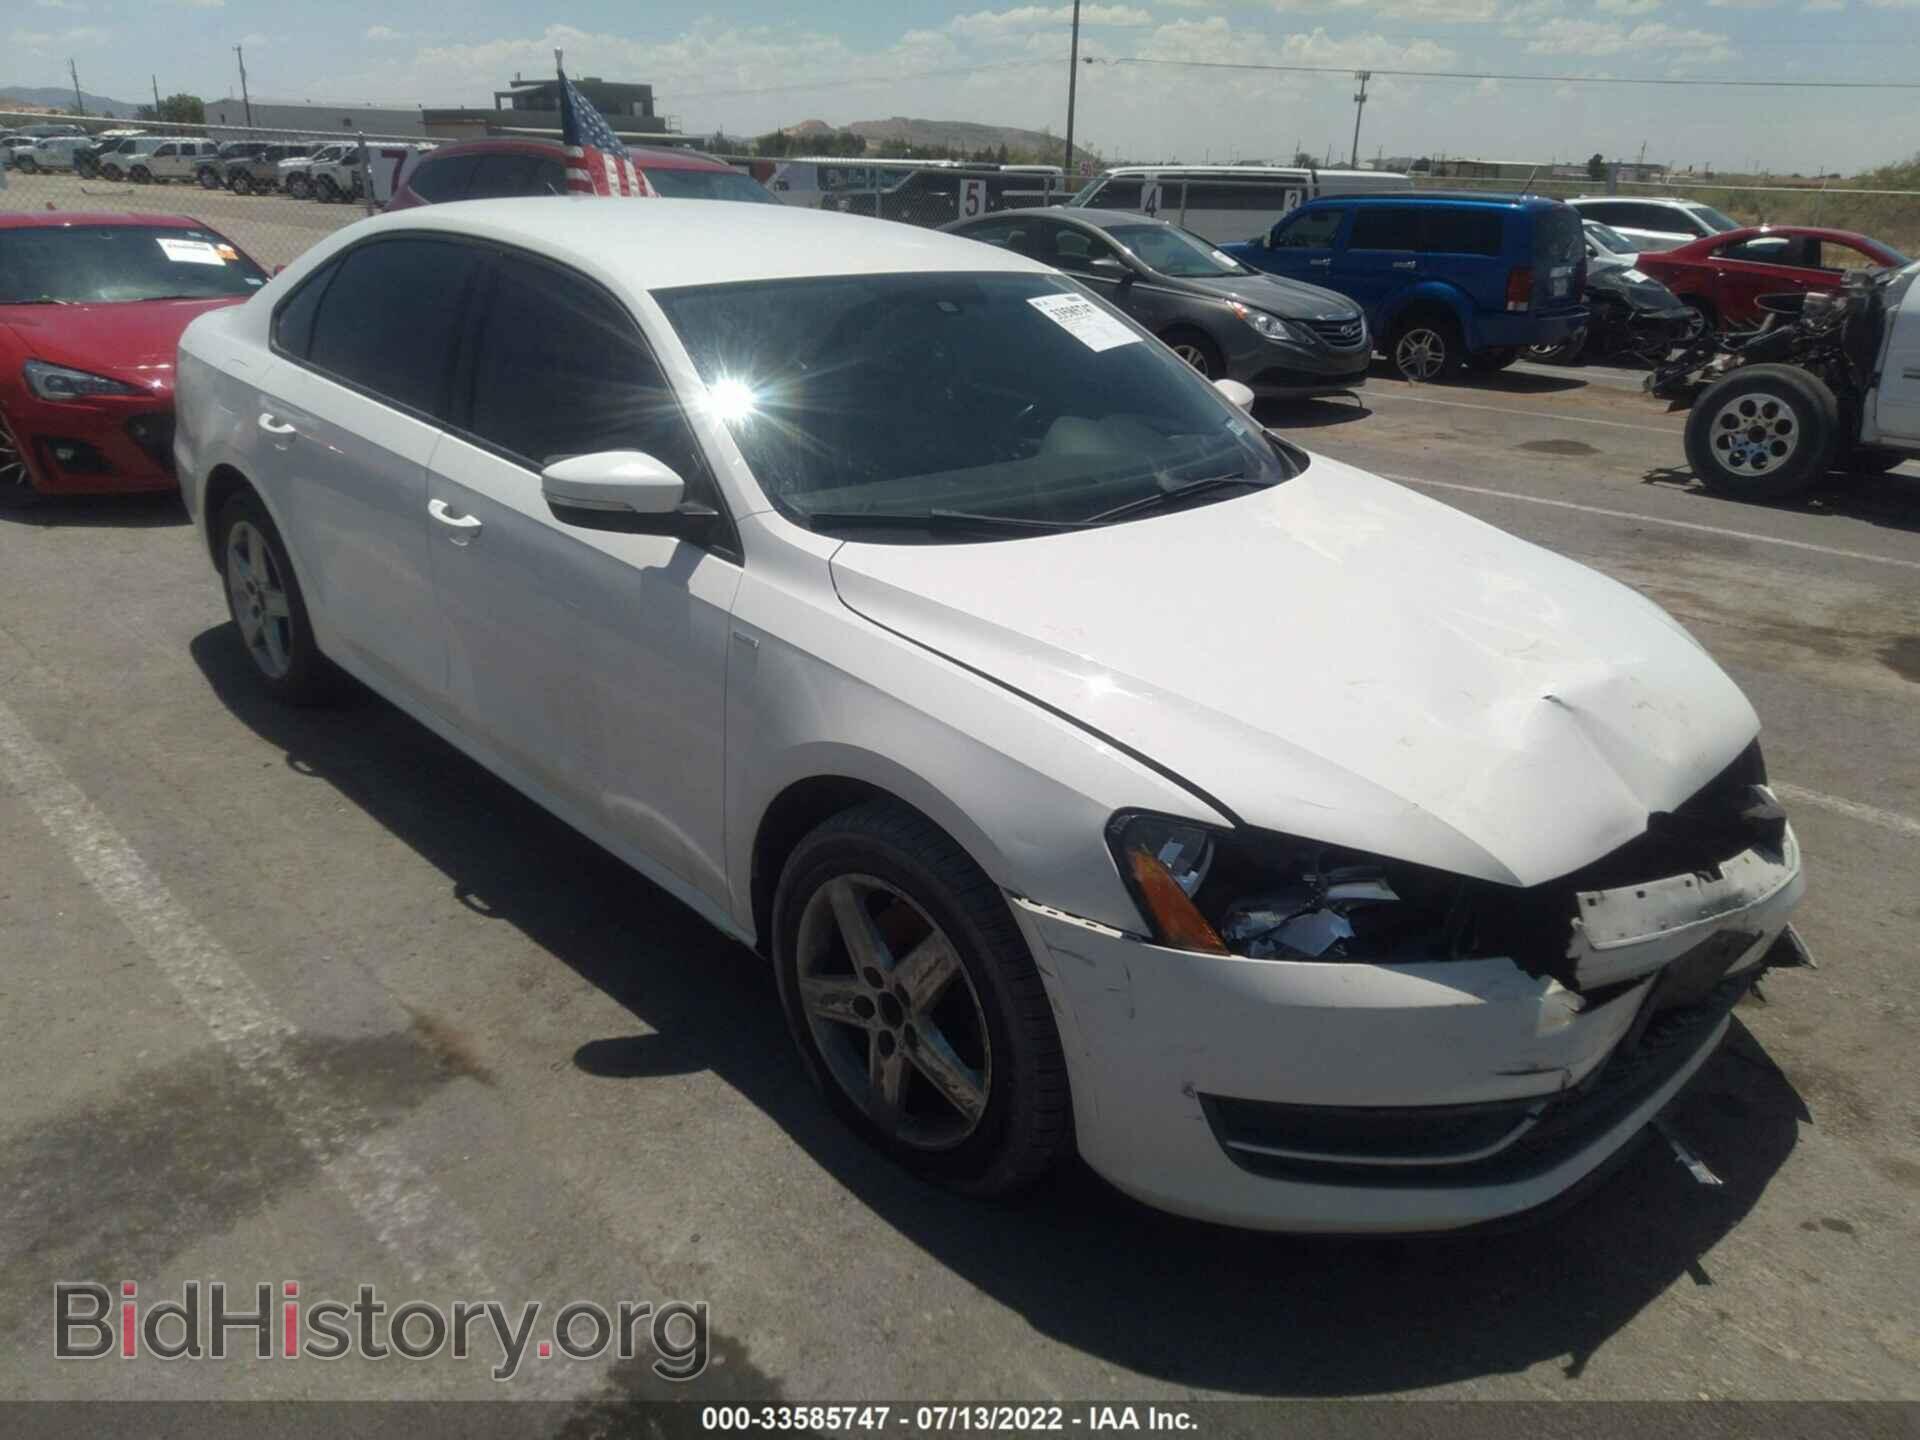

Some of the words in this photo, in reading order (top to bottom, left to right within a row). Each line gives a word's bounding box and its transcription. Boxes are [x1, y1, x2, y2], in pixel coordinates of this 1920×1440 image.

[381, 149, 408, 196] 7
[965, 182, 979, 217] 5
[1144, 185, 1157, 218] 4
